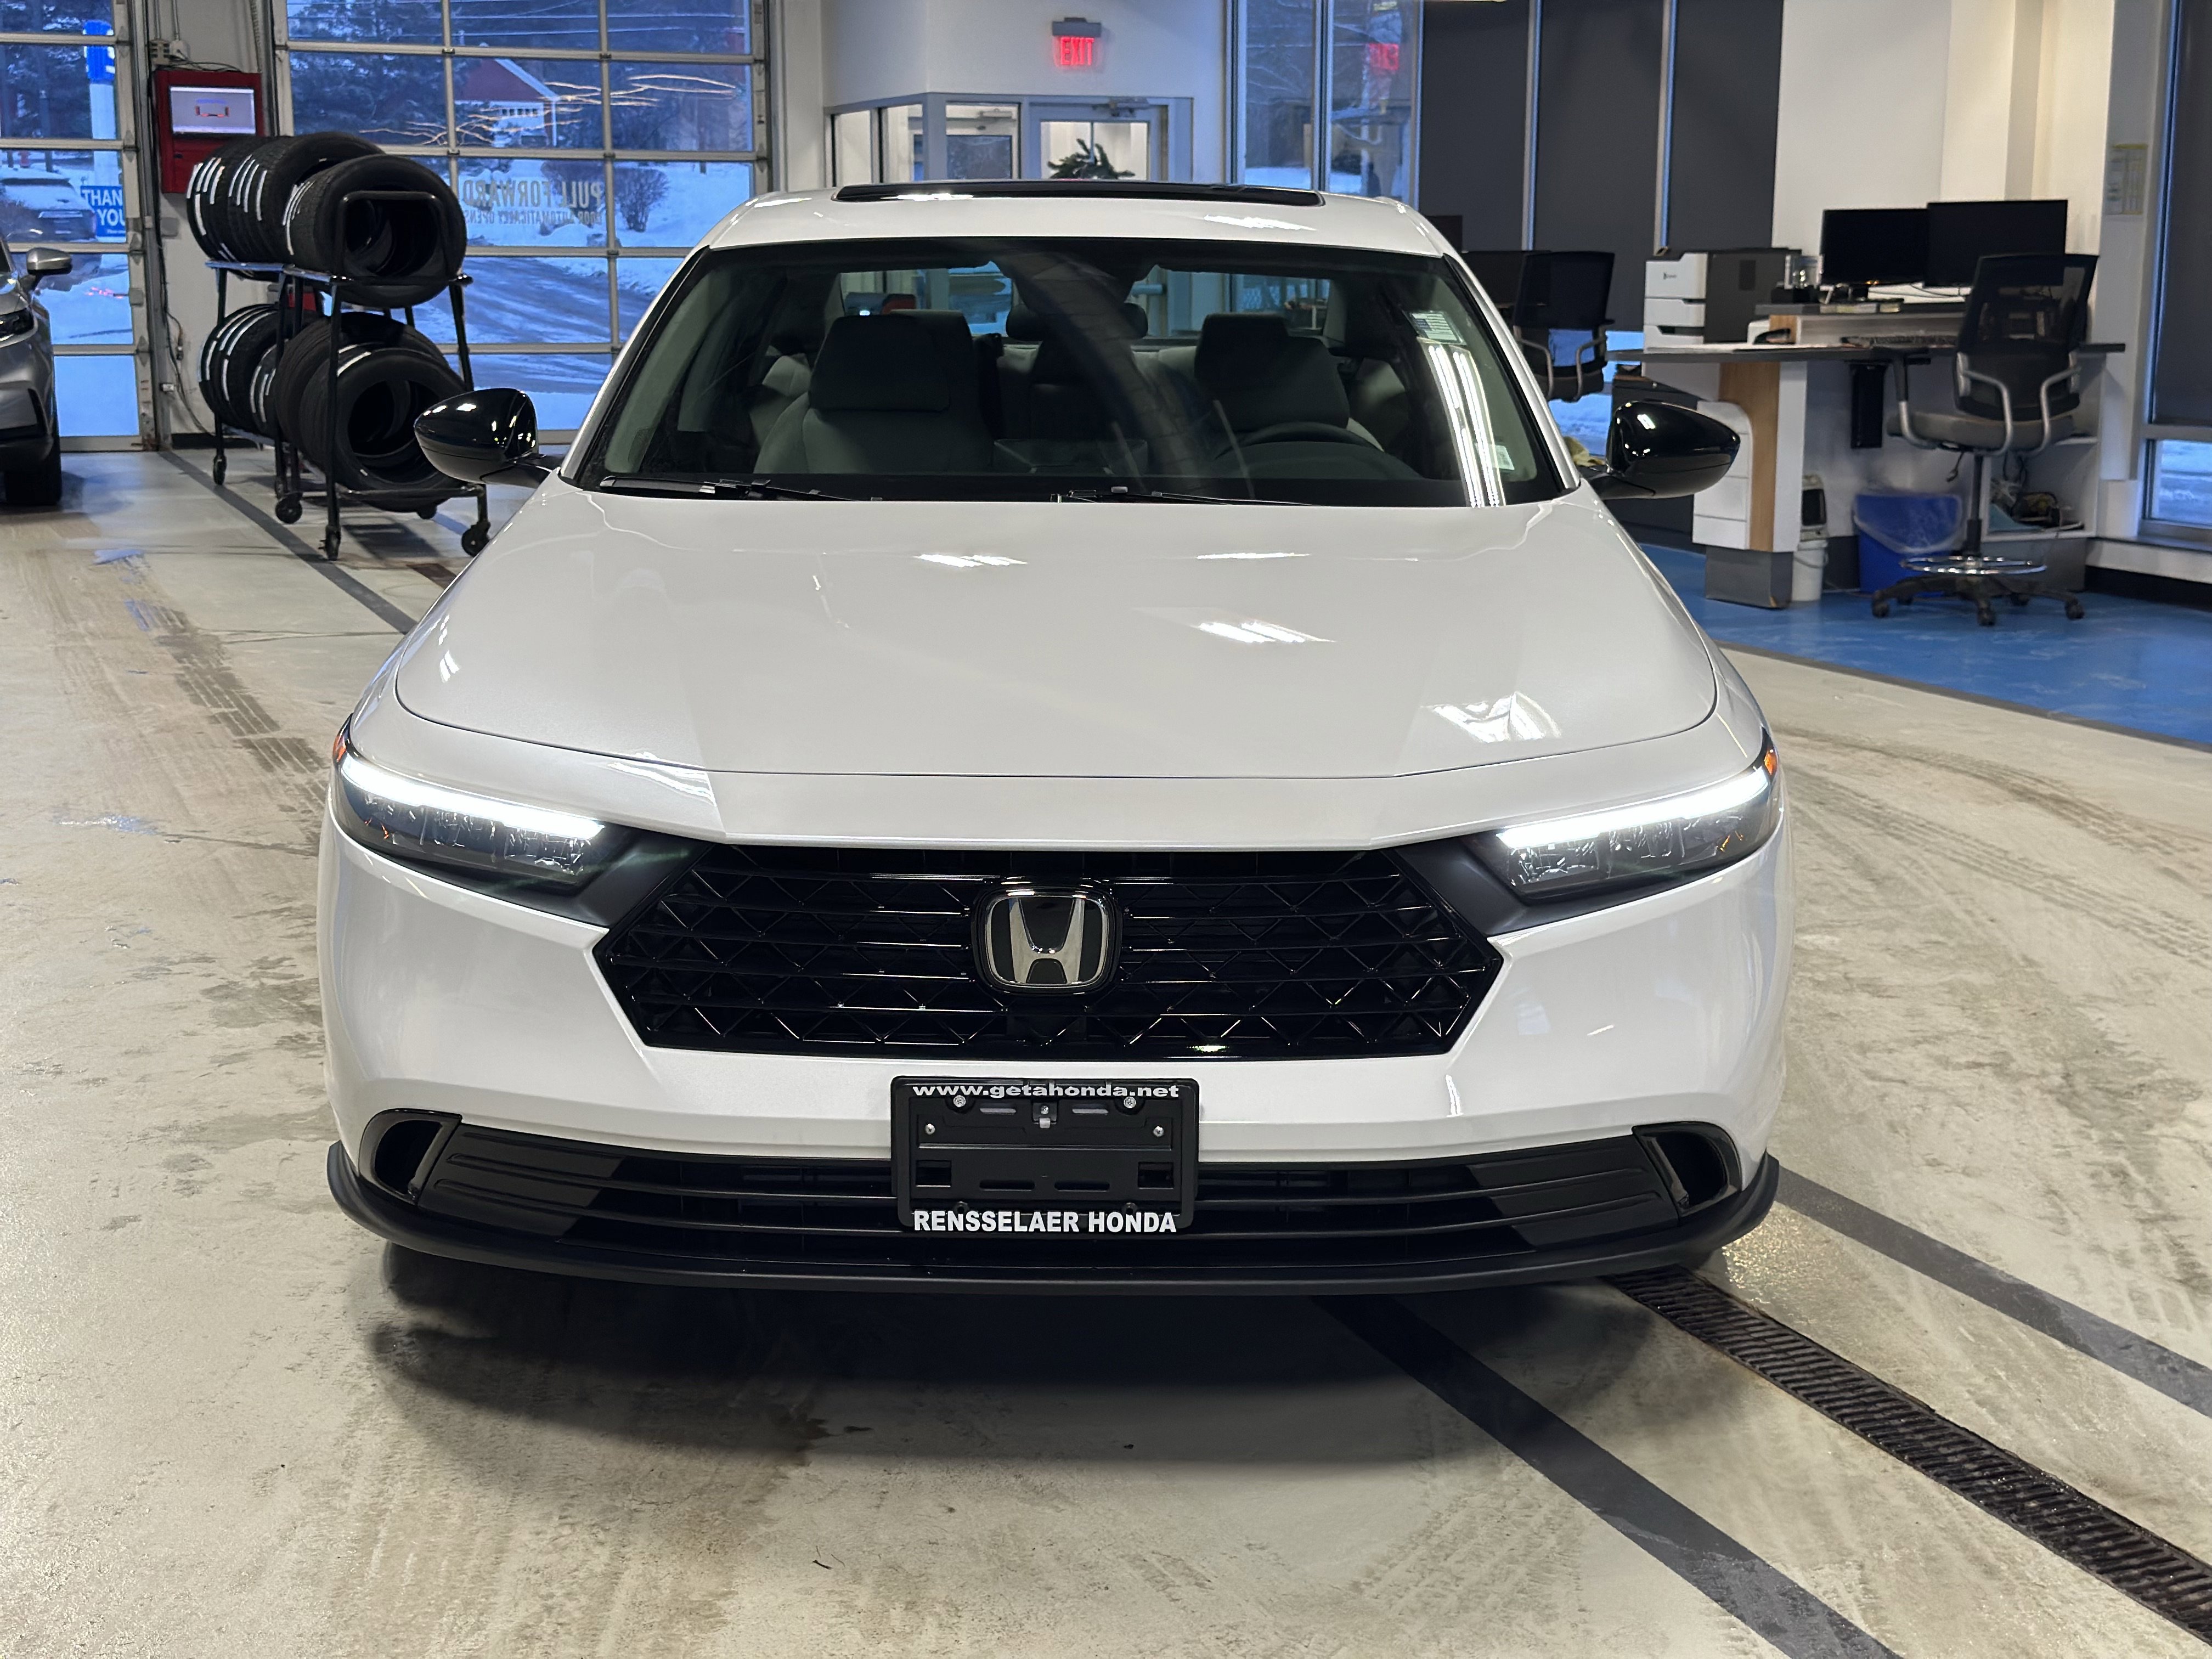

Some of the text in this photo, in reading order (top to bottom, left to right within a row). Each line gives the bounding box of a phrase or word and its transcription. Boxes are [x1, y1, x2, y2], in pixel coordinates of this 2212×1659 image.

[1061, 37, 1094, 65] EXIT
[81, 189, 123, 206] THAN
[912, 1084, 1180, 1098] www.getahonda.net
[913, 1210, 1177, 1233] RENSSELAER HONDA
